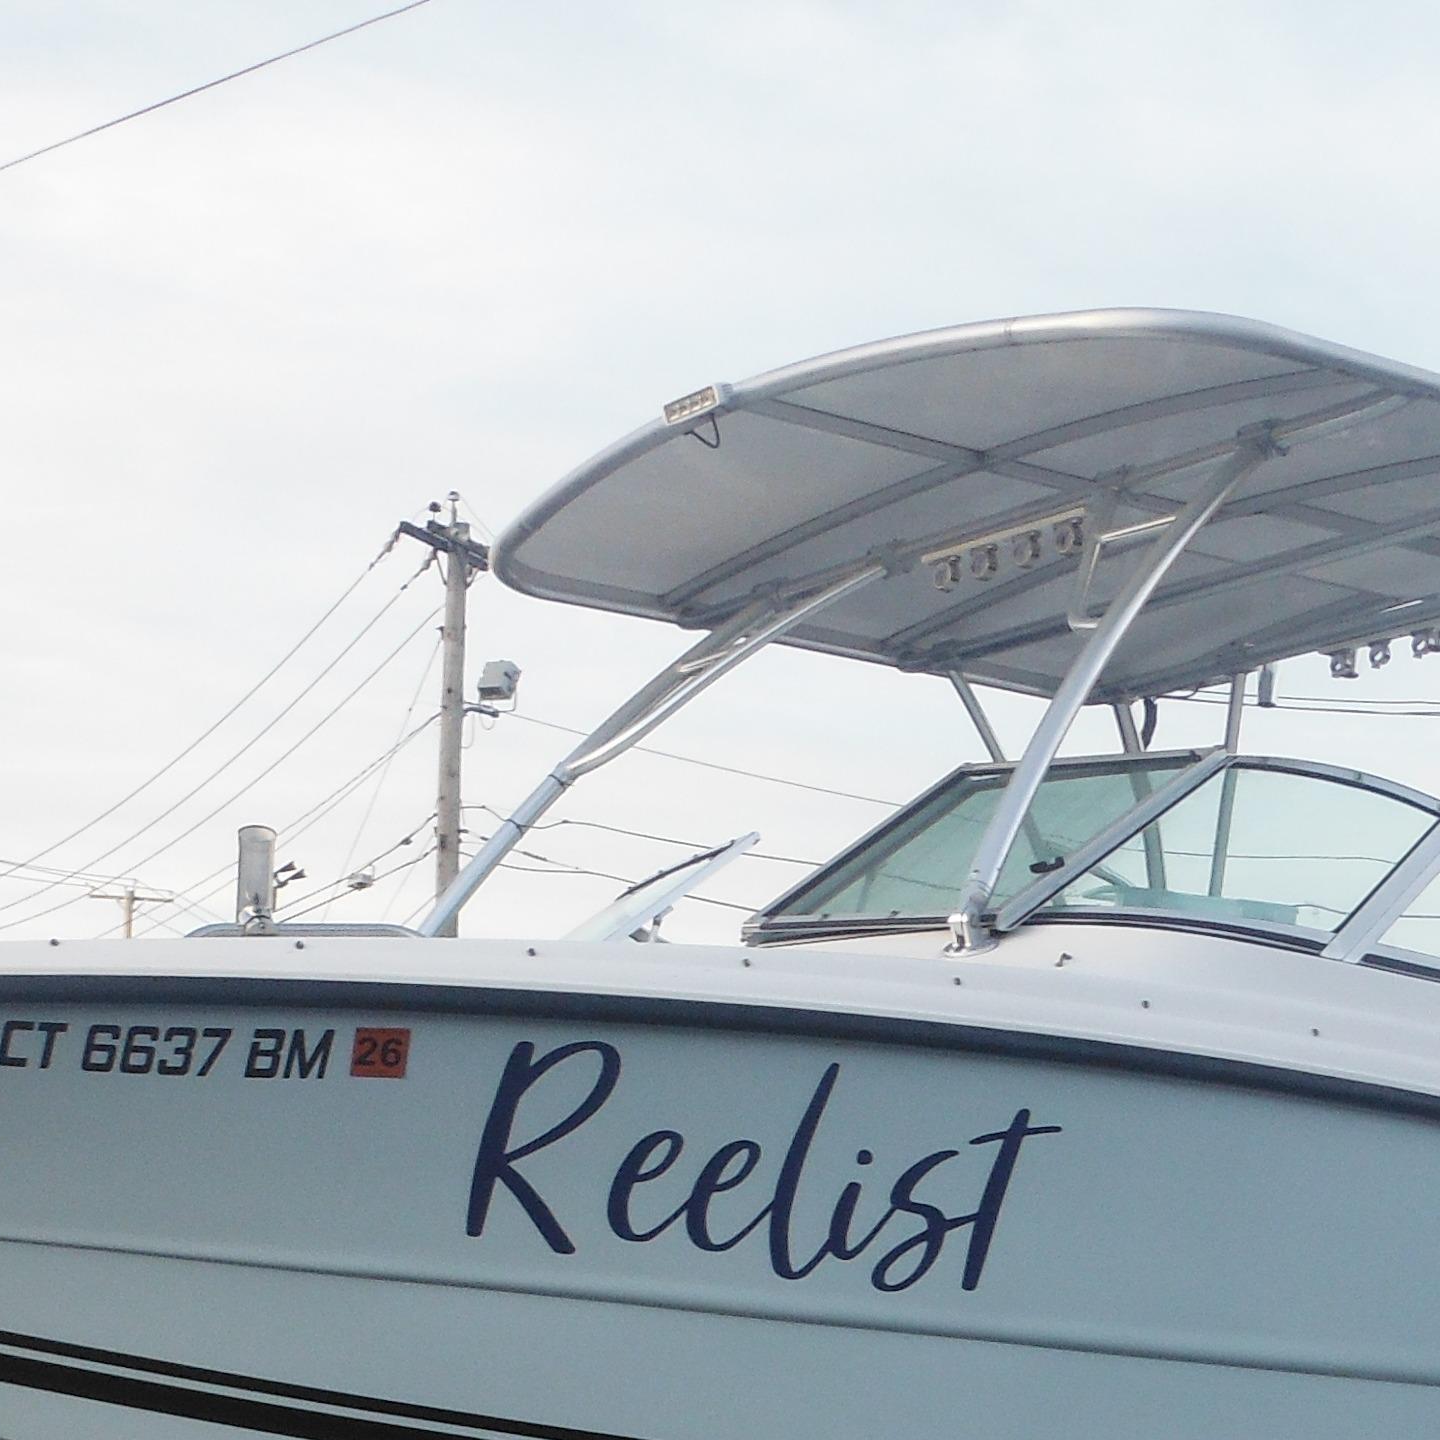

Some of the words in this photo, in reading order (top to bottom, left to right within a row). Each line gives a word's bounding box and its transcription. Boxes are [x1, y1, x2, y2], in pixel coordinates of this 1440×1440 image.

[82, 1024, 233, 1077] 6637
[245, 1028, 336, 1080] BM
[359, 1036, 404, 1067] 26
[465, 1040, 1062, 1292] Reelist
